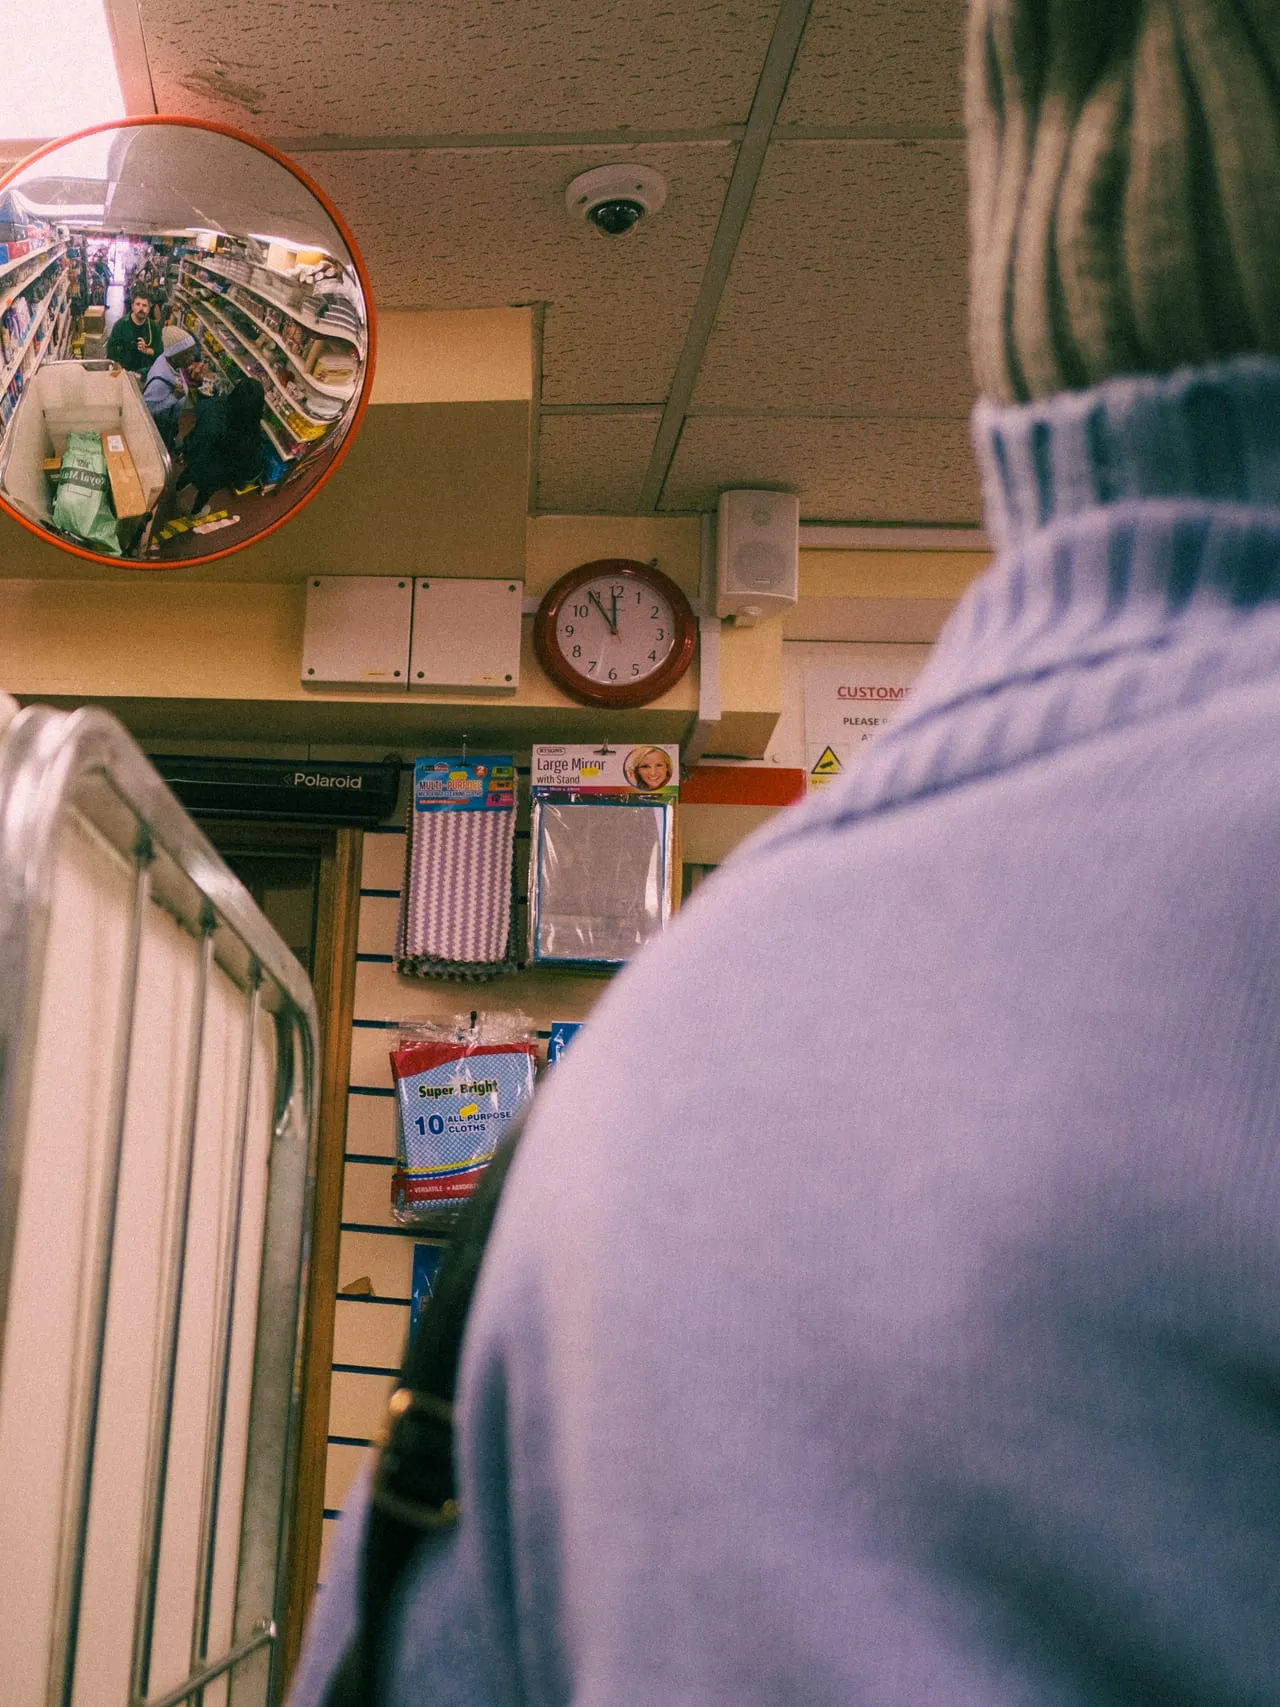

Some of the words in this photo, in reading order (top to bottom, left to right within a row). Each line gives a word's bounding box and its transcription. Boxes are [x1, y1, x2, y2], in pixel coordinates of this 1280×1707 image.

[609, 585, 624, 599] 12
[636, 592, 641, 604] 1
[573, 604, 589, 618] 10
[650, 606, 659, 619] 2
[565, 624, 574, 638] 9
[655, 628, 664, 641] 3
[572, 645, 582, 658] 8
[648, 650, 656, 661] 4
[588, 661, 597, 673] 7
[608, 667, 618, 680] 6
[632, 664, 640, 676] 5
[837, 686, 913, 699] CUSTOME
[843, 716, 880, 726] PLEASE
[537, 757, 569, 774] Large
[571, 757, 606, 771] Mirror
[294, 772, 362, 789] Polaroid
[536, 775, 555, 784] with
[556, 775, 580, 784] Stand
[418, 1085, 455, 1099] Super
[460, 1080, 499, 1097] Bright
[448, 1114, 466, 1122] ALL
[467, 1110, 513, 1122] PURPOSE
[414, 1114, 445, 1136] 10
[448, 1123, 487, 1133] CLOTHS
